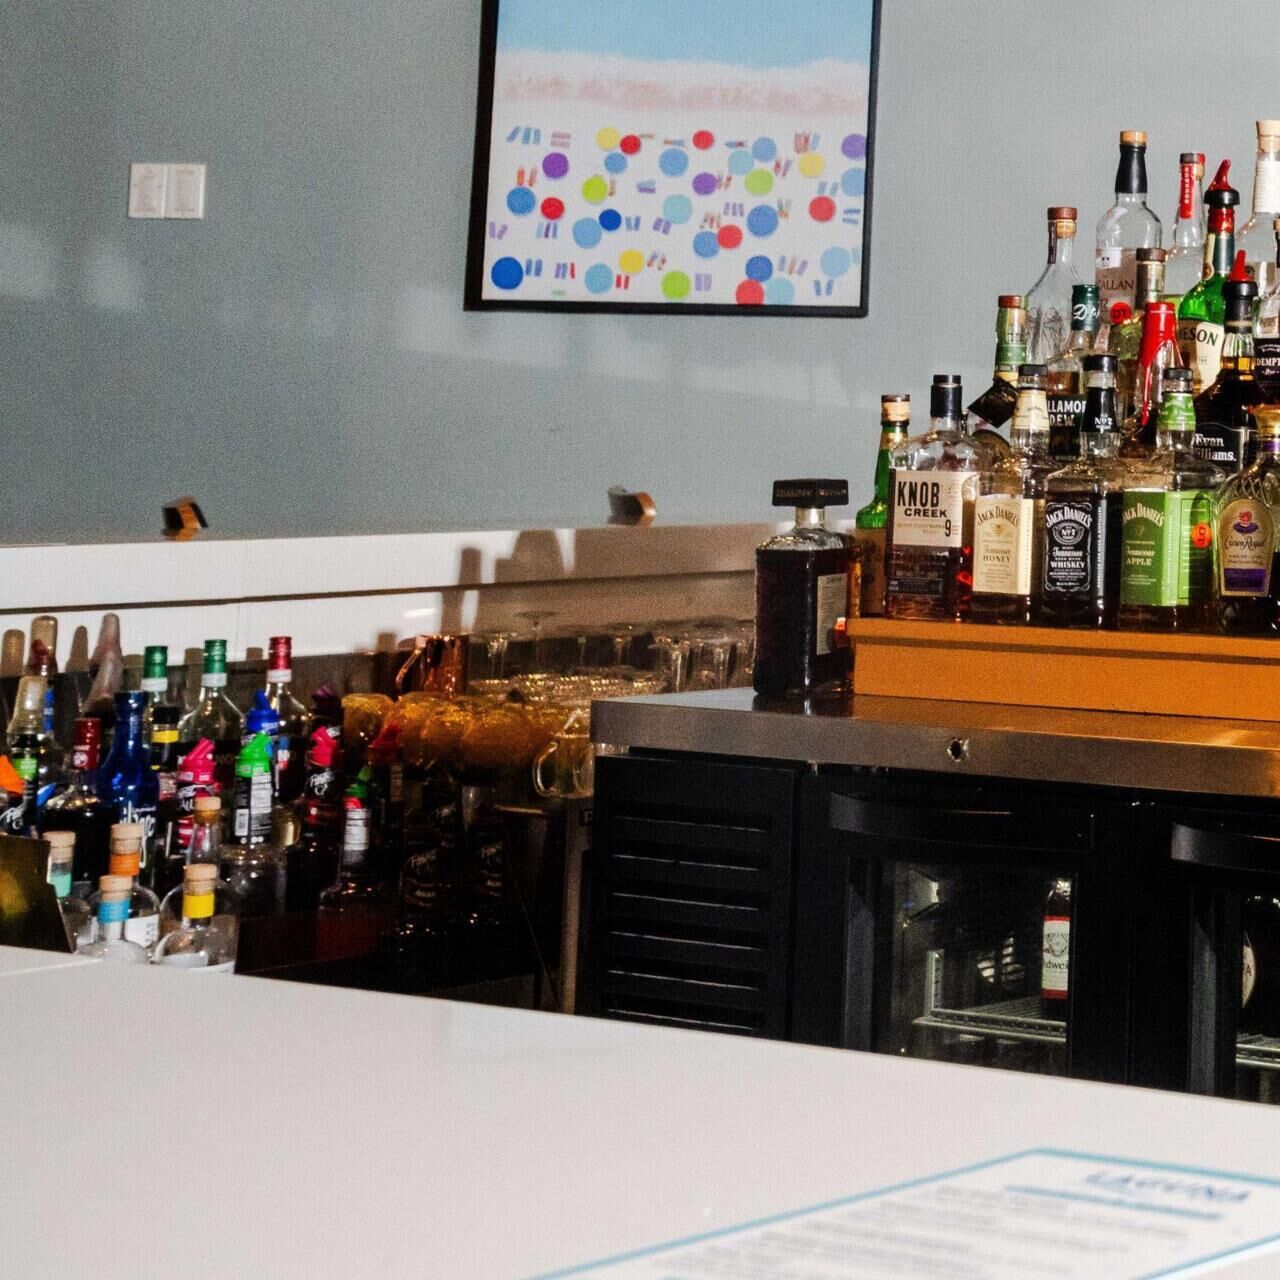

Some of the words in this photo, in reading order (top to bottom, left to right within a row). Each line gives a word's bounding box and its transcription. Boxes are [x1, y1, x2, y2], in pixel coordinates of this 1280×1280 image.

[1100, 279, 1135, 291] ALLAN
[1182, 327, 1219, 347] ESON
[1047, 400, 1087, 413] LLAMO
[1195, 433, 1224, 447] Evan
[1197, 447, 1237, 462] illiams.
[897, 481, 940, 508] KNOB
[904, 508, 948, 518] CREEK
[977, 509, 995, 526] JACK
[1046, 508, 1064, 528] JACK
[1063, 505, 1093, 529] DANIEL'S
[1136, 503, 1165, 528] DANIEL'S
[944, 519, 952, 537] 9
[983, 555, 1012, 563] HONEY
[1050, 561, 1086, 569] WHISKEY
[1126, 557, 1153, 566] APPLE
